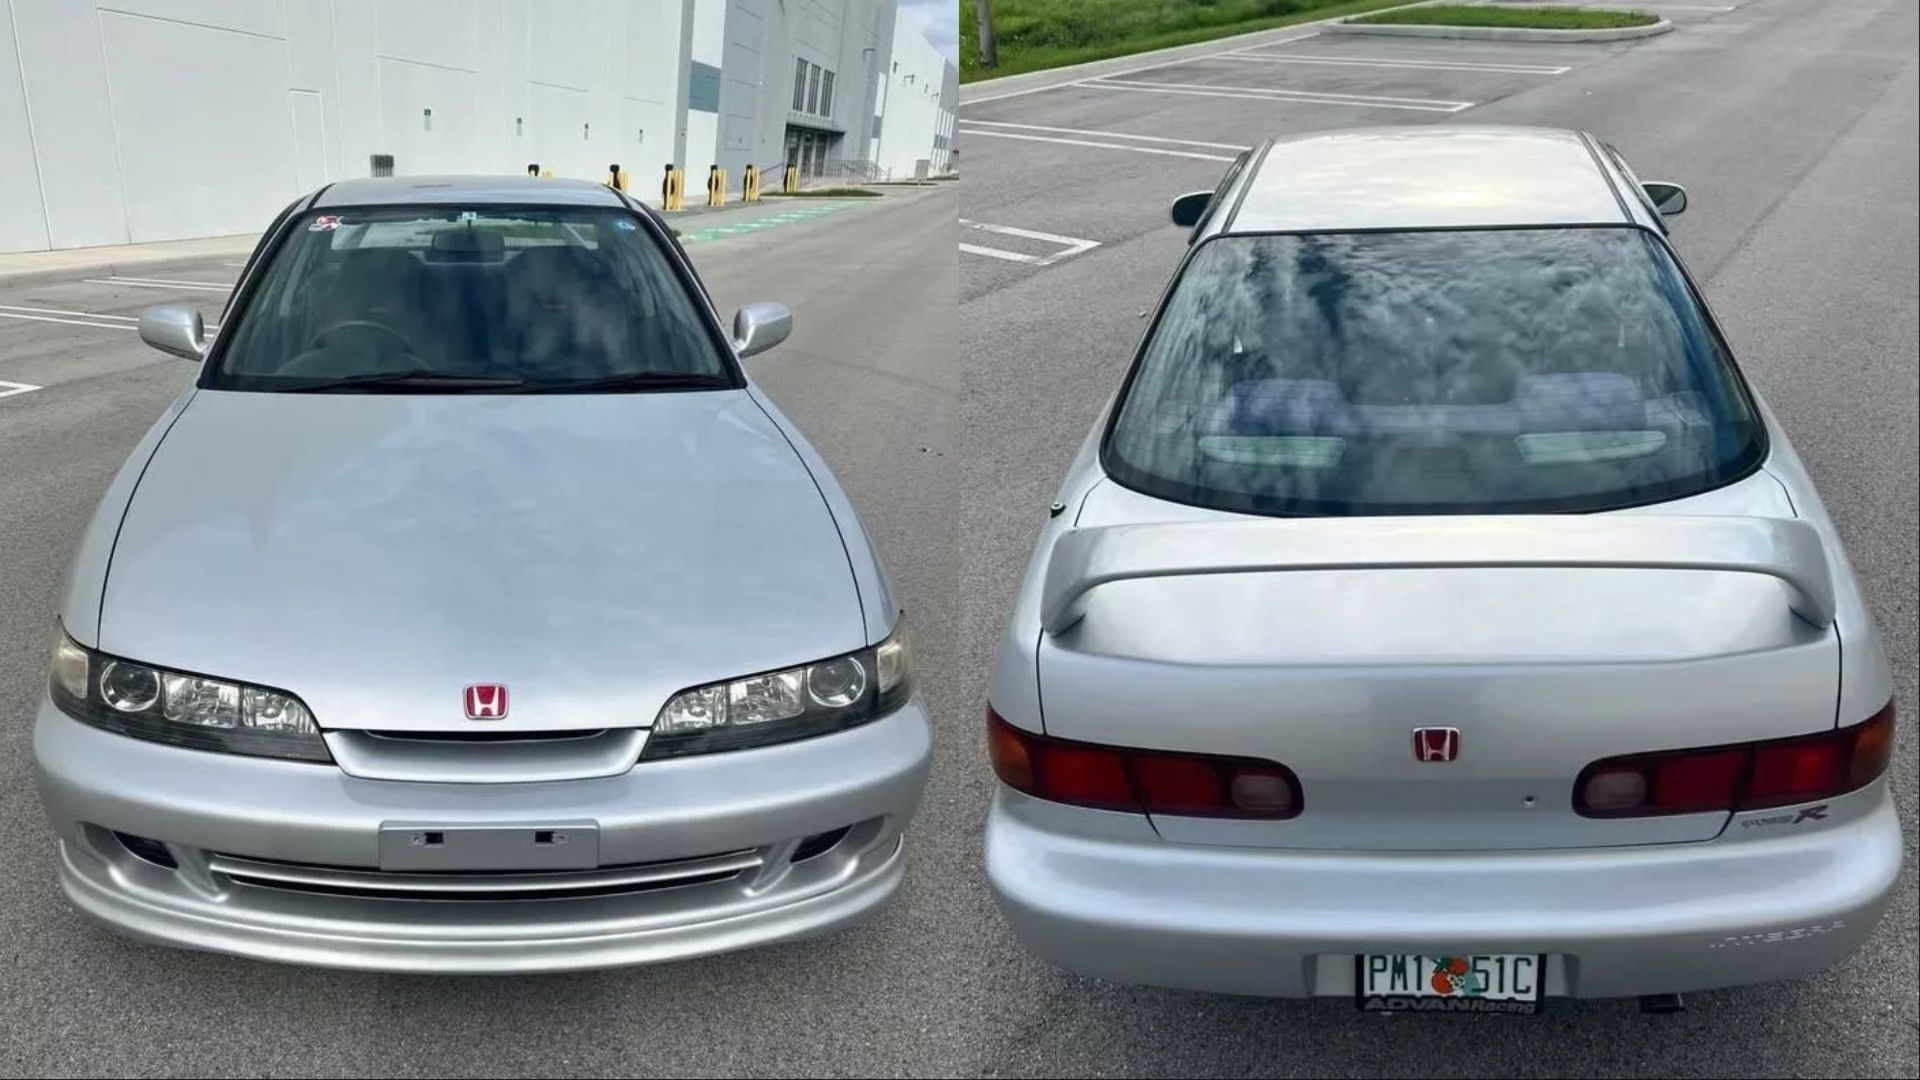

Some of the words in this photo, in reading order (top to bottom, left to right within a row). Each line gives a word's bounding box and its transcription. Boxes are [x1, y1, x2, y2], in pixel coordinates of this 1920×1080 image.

[1369, 954, 1422, 991] PM1
[1472, 956, 1532, 994] 51C
[1364, 997, 1470, 1012] ADVAN
